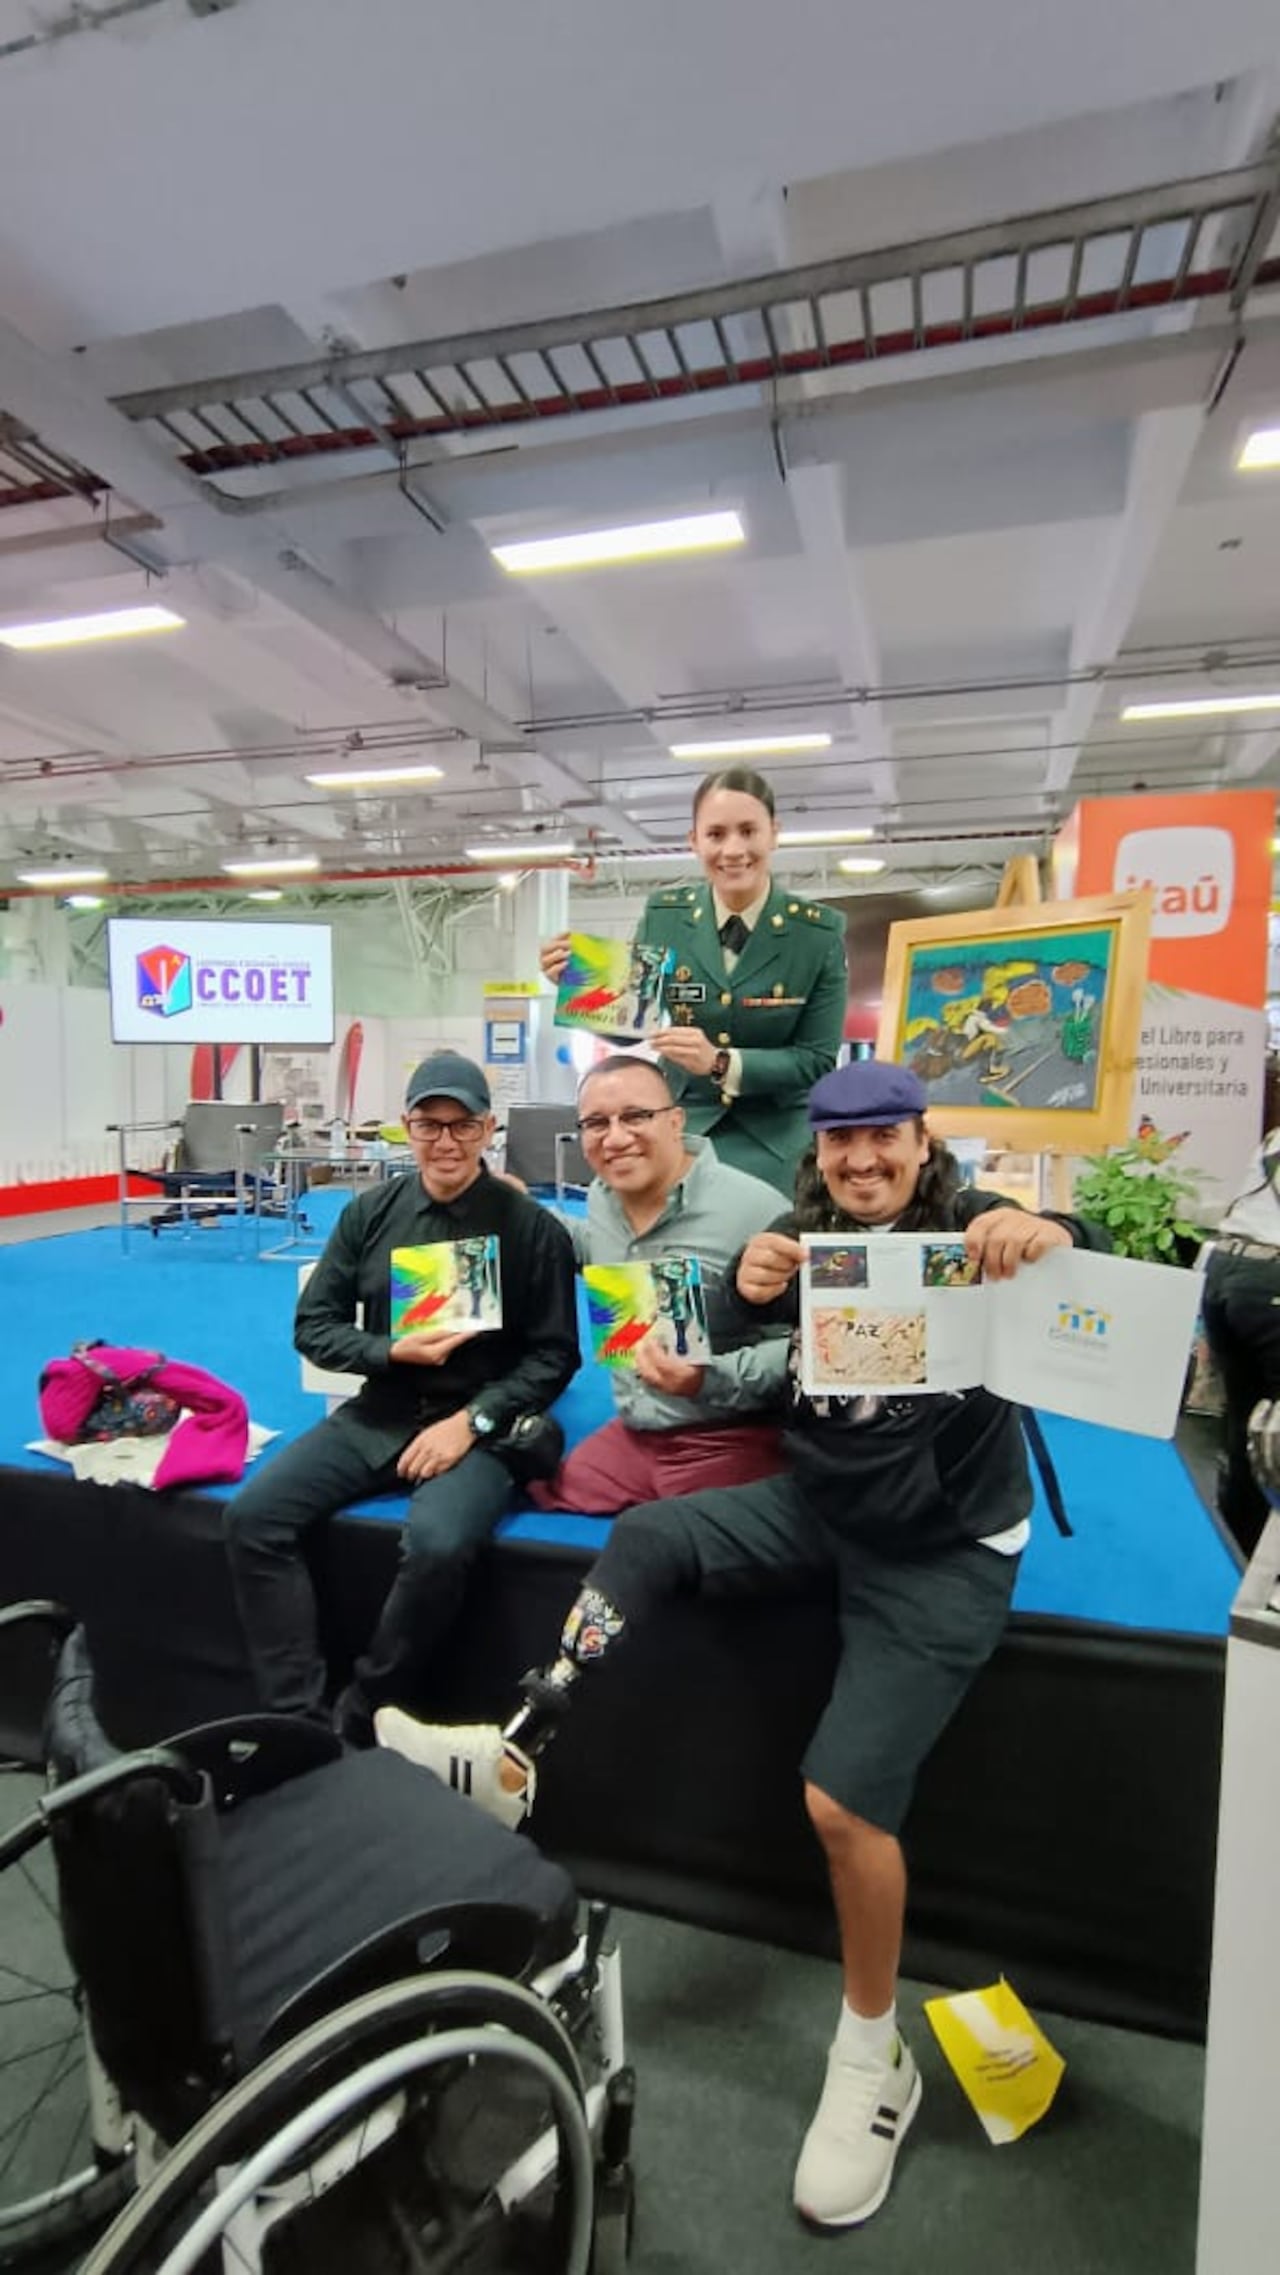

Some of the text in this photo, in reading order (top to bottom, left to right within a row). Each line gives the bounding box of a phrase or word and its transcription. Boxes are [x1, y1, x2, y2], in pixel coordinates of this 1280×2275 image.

[196, 968, 311, 1002] CCOET
[1160, 1027, 1202, 1045] Libro
[1206, 1030, 1244, 1048] para
[1136, 1053, 1229, 1074] esionales y
[1141, 1076, 1248, 1096] Universitaria
[845, 1320, 881, 1338] PAZ
